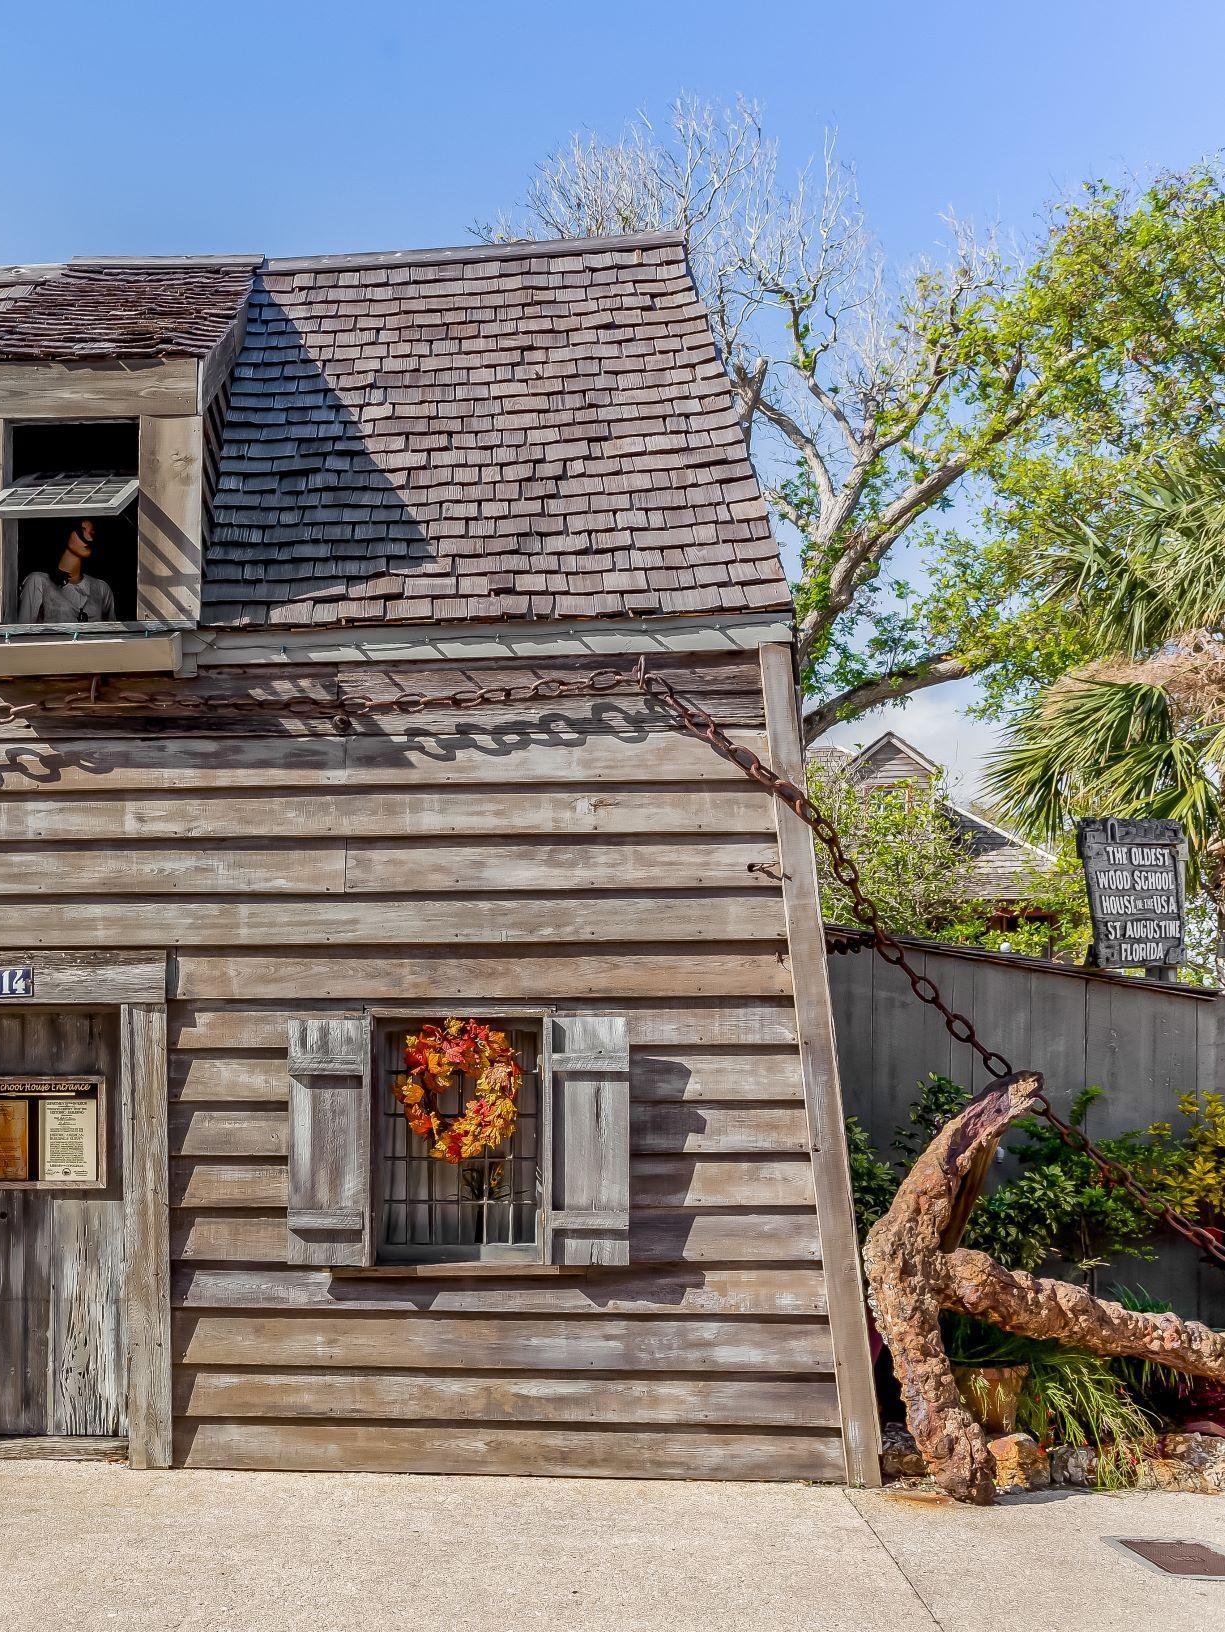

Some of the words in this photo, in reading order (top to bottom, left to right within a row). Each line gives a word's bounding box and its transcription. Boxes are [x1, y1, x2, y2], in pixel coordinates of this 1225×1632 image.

[1106, 847, 1128, 865] THE
[1131, 847, 1170, 866] OLDEST
[1096, 870, 1131, 889] WOOD
[1133, 871, 1175, 891] SCHOOL
[1101, 895, 1136, 914] HOUSE
[1126, 921, 1181, 939] AUGUSTINE
[1121, 943, 1164, 962] FLORIDA
[2, 970, 26, 994] 14
[25, 1083, 51, 1091] House
[51, 1083, 91, 1091] Entrance
